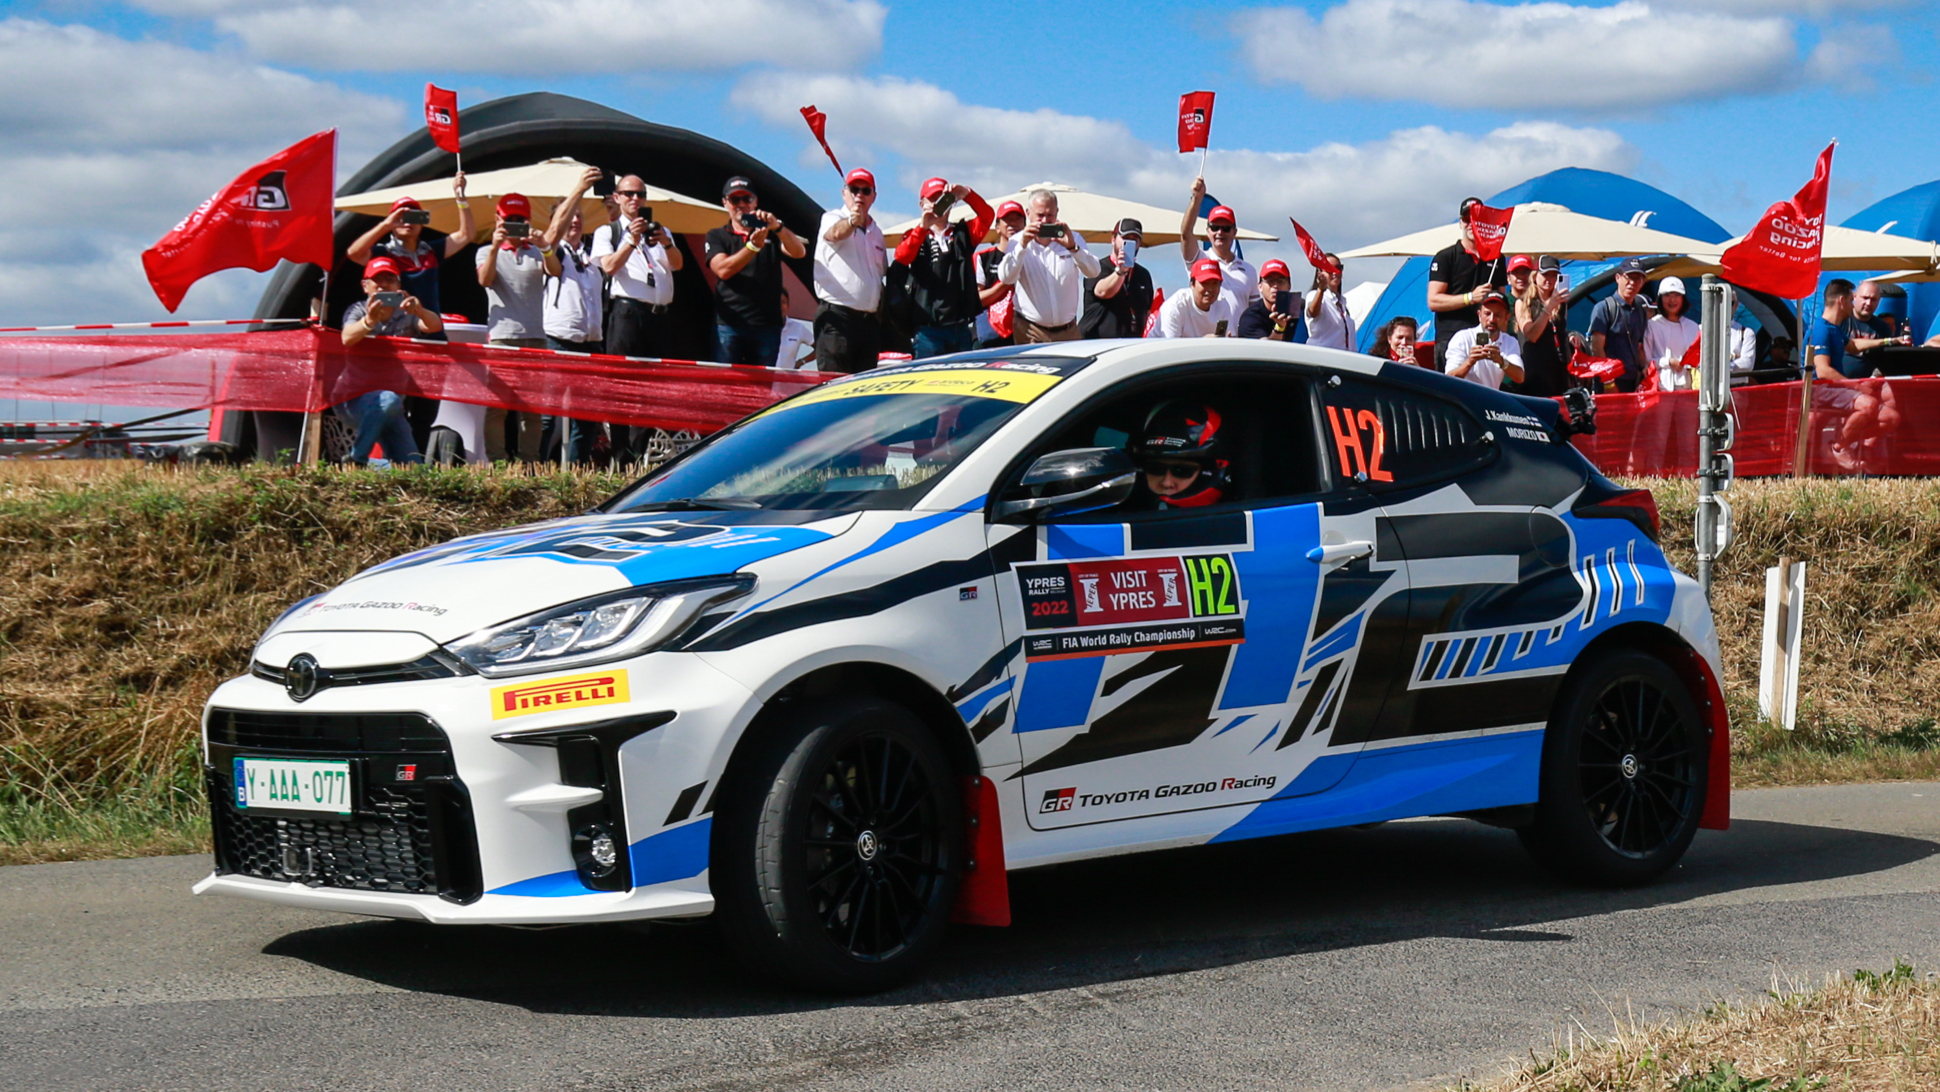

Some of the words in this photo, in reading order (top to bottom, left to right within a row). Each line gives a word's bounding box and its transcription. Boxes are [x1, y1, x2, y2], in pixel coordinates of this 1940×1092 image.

[985, 361, 1061, 375] Racing
[971, 380, 1011, 394] H2
[1506, 427, 1538, 441] MORIZO
[1326, 405, 1394, 483] H2
[1026, 576, 1065, 589] YPRES
[1110, 570, 1147, 589] VISIT
[1186, 557, 1236, 616] H2
[960, 589, 977, 599] GR
[1028, 588, 1050, 596] RALLY
[360, 600, 402, 610] GAZOO
[402, 602, 448, 617] Racing
[1032, 600, 1069, 616] 2022
[1109, 591, 1156, 611] YPRES
[1062, 636, 1079, 649] FIA
[1080, 634, 1107, 647] World
[1109, 632, 1132, 645] Rally
[1134, 627, 1196, 643] Championship
[503, 676, 615, 712] PIRELLI
[397, 768, 415, 780] GR
[237, 786, 246, 802] B
[1040, 792, 1075, 813] GR
[1079, 789, 1150, 807] TOYOTA
[1154, 781, 1217, 798] GAZOO
[1220, 774, 1277, 790] Racing
